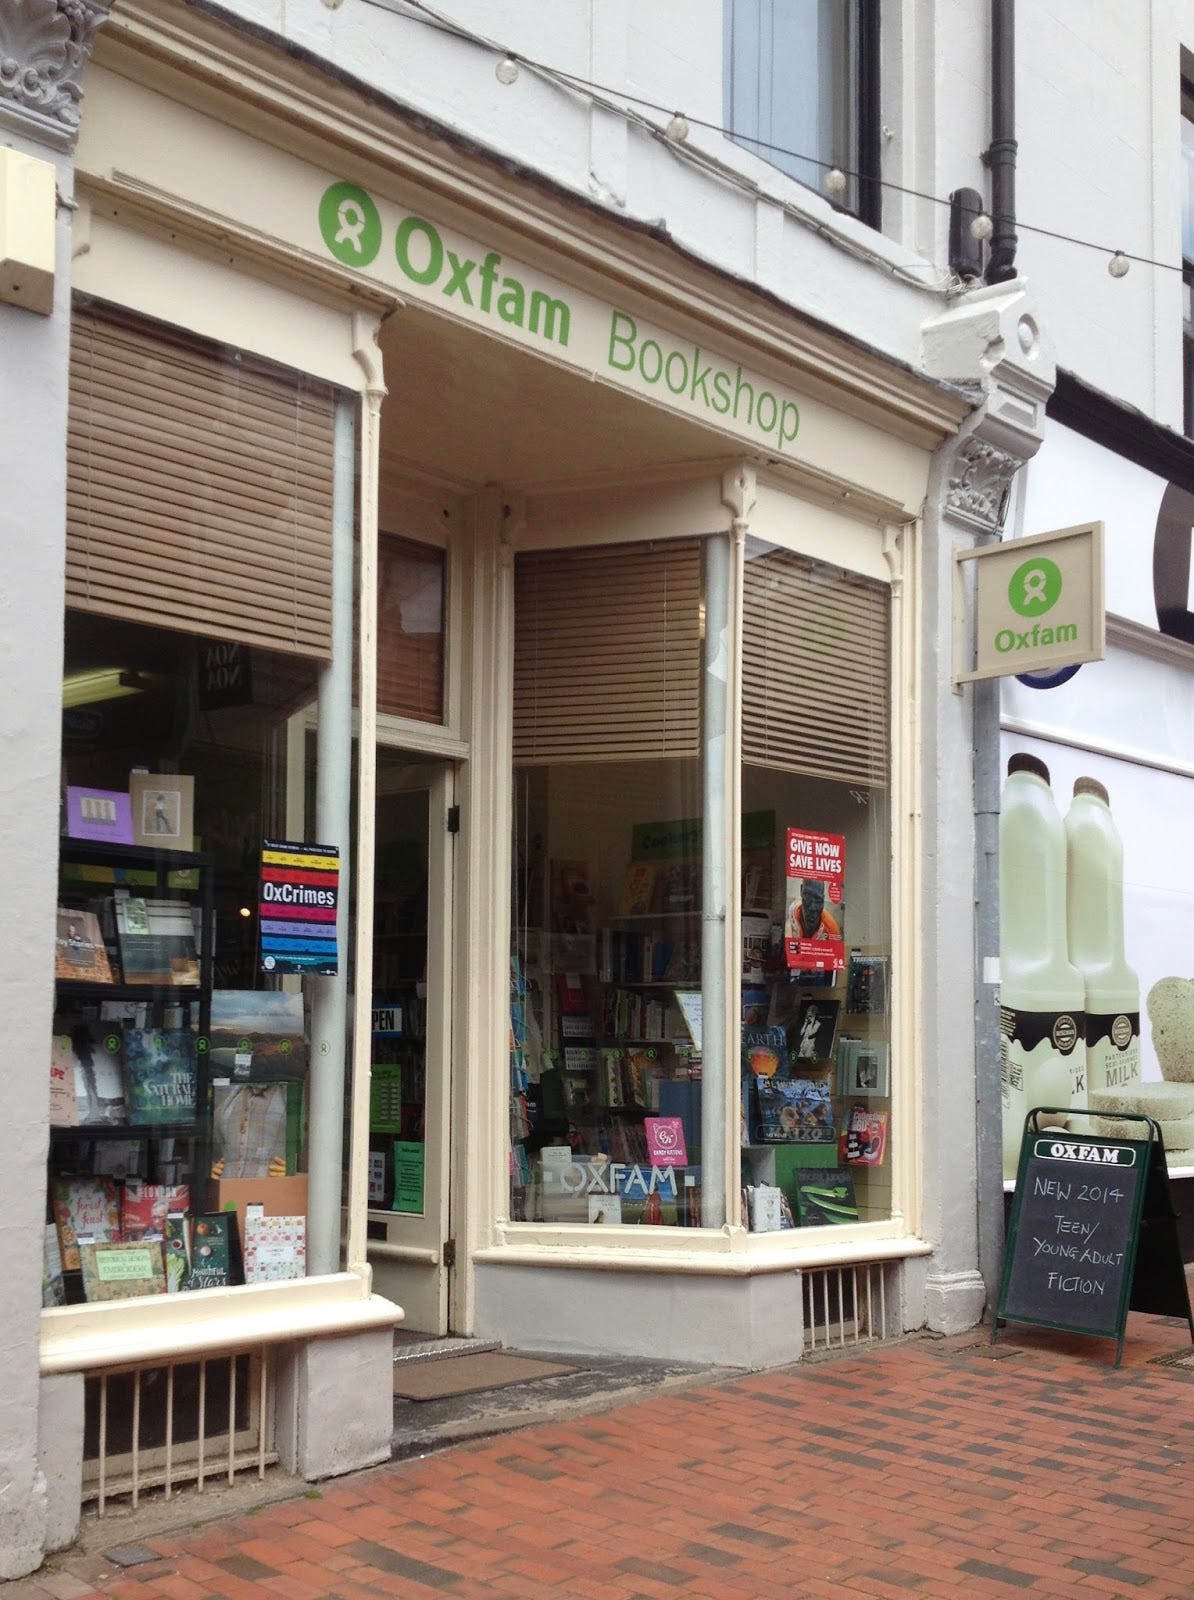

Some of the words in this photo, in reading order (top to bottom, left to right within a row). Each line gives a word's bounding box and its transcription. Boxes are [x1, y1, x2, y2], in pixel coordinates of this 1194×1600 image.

[395, 216, 571, 347] Oxfam
[607, 309, 800, 449] Bookshop
[994, 623, 1078, 653] Oxfam
[790, 838, 813, 855] GIVE
[815, 842, 840, 858] NOW
[790, 853, 814, 870] SAVE
[815, 857, 842, 874] LIVES
[263, 882, 335, 905] OxCrimes
[372, 1010, 395, 1031] PEN
[170, 1072, 195, 1084] THE
[1106, 1063, 1139, 1088] MILK
[1050, 1143, 1120, 1164] OXFAM
[560, 1163, 678, 1196] OXFAM
[1033, 1177, 1072, 1201] NEW
[1077, 1184, 1126, 1204] 2014
[1054, 1215, 1100, 1245] TEEN/
[1033, 1237, 1080, 1260] YOUNG
[1080, 1248, 1124, 1266] ADULT
[1048, 1272, 1105, 1296] FICTION
